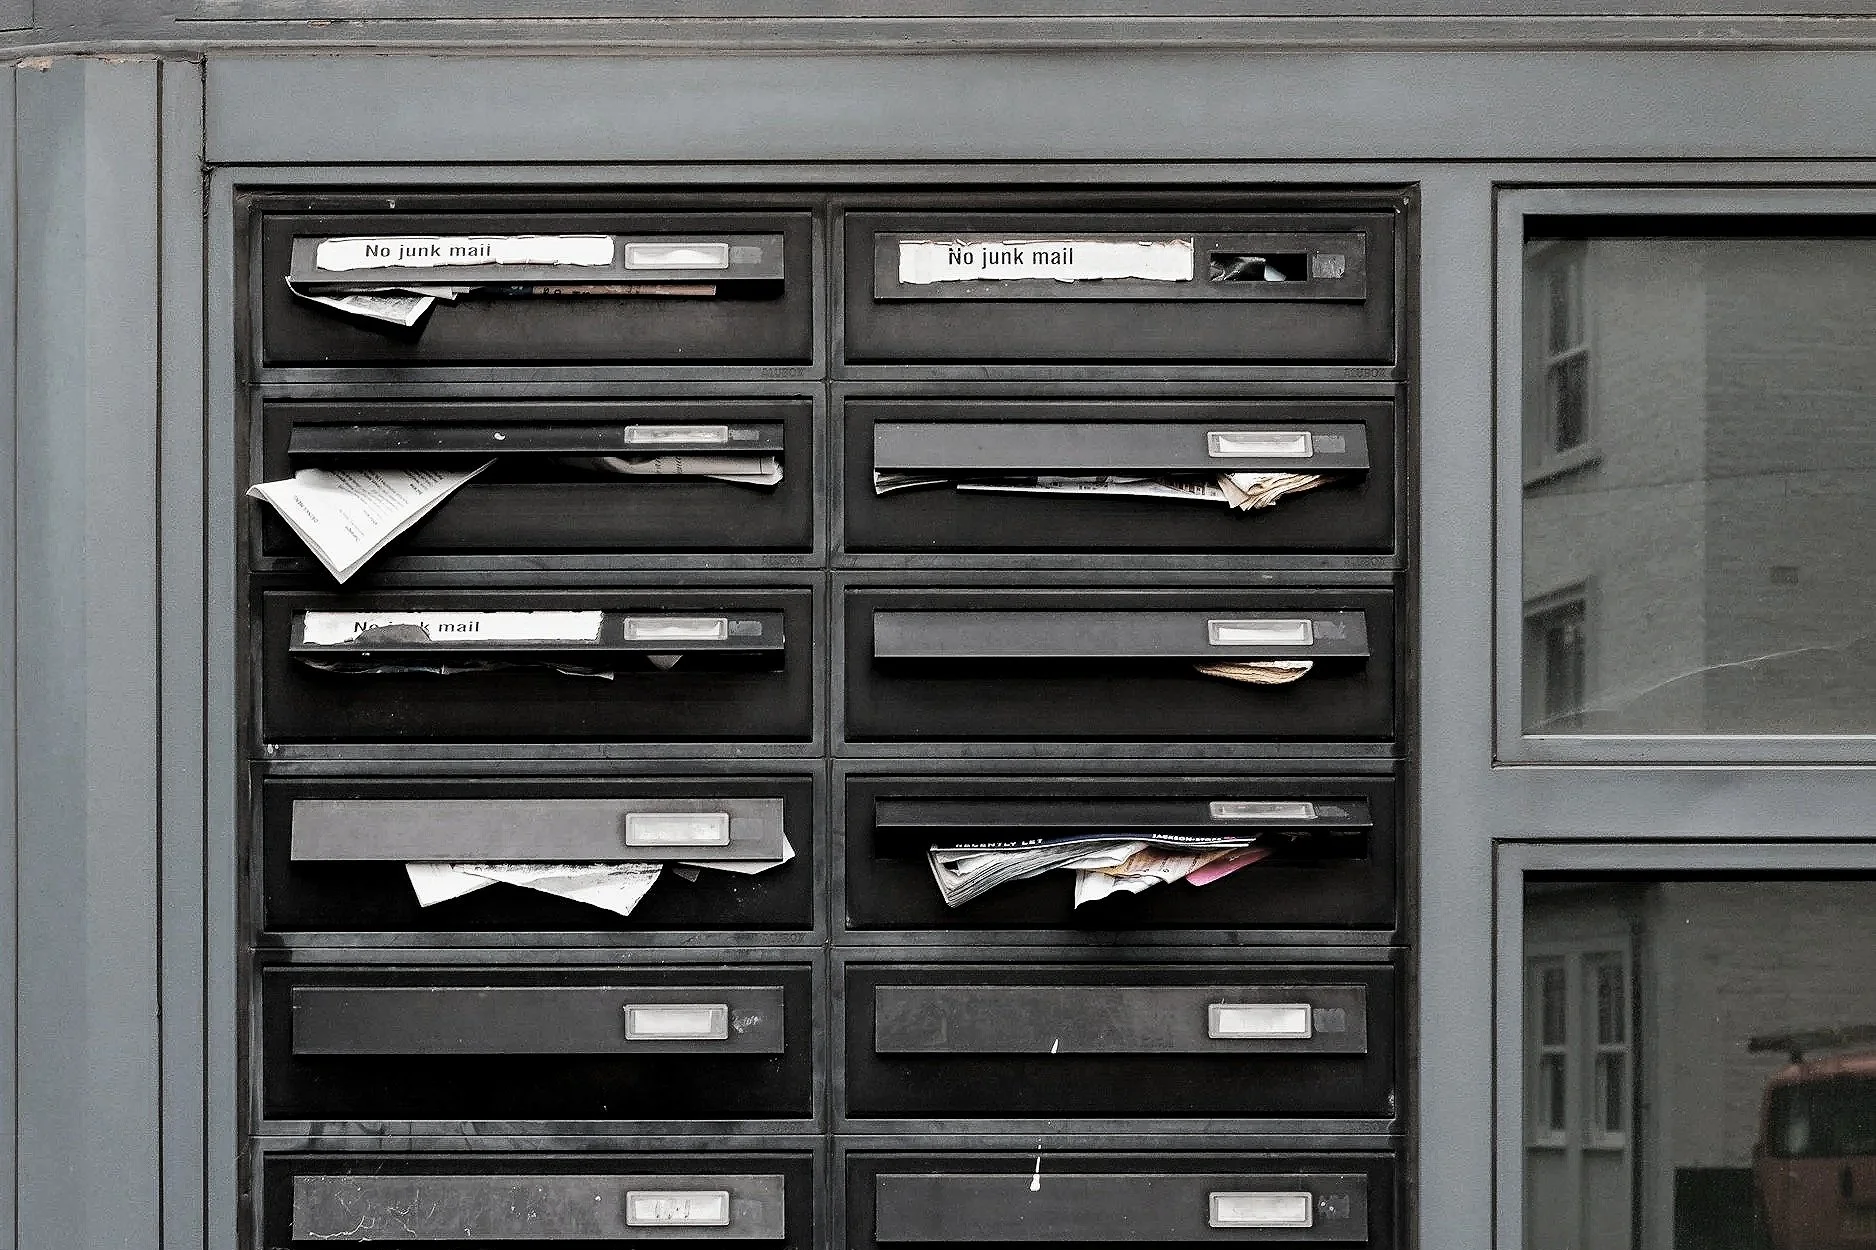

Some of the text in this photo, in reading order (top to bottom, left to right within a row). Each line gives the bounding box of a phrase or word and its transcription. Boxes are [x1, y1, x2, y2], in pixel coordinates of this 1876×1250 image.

[365, 244, 391, 257] No
[398, 244, 441, 261] junk
[948, 247, 1074, 270] No junk mail
[438, 621, 480, 633] mail
